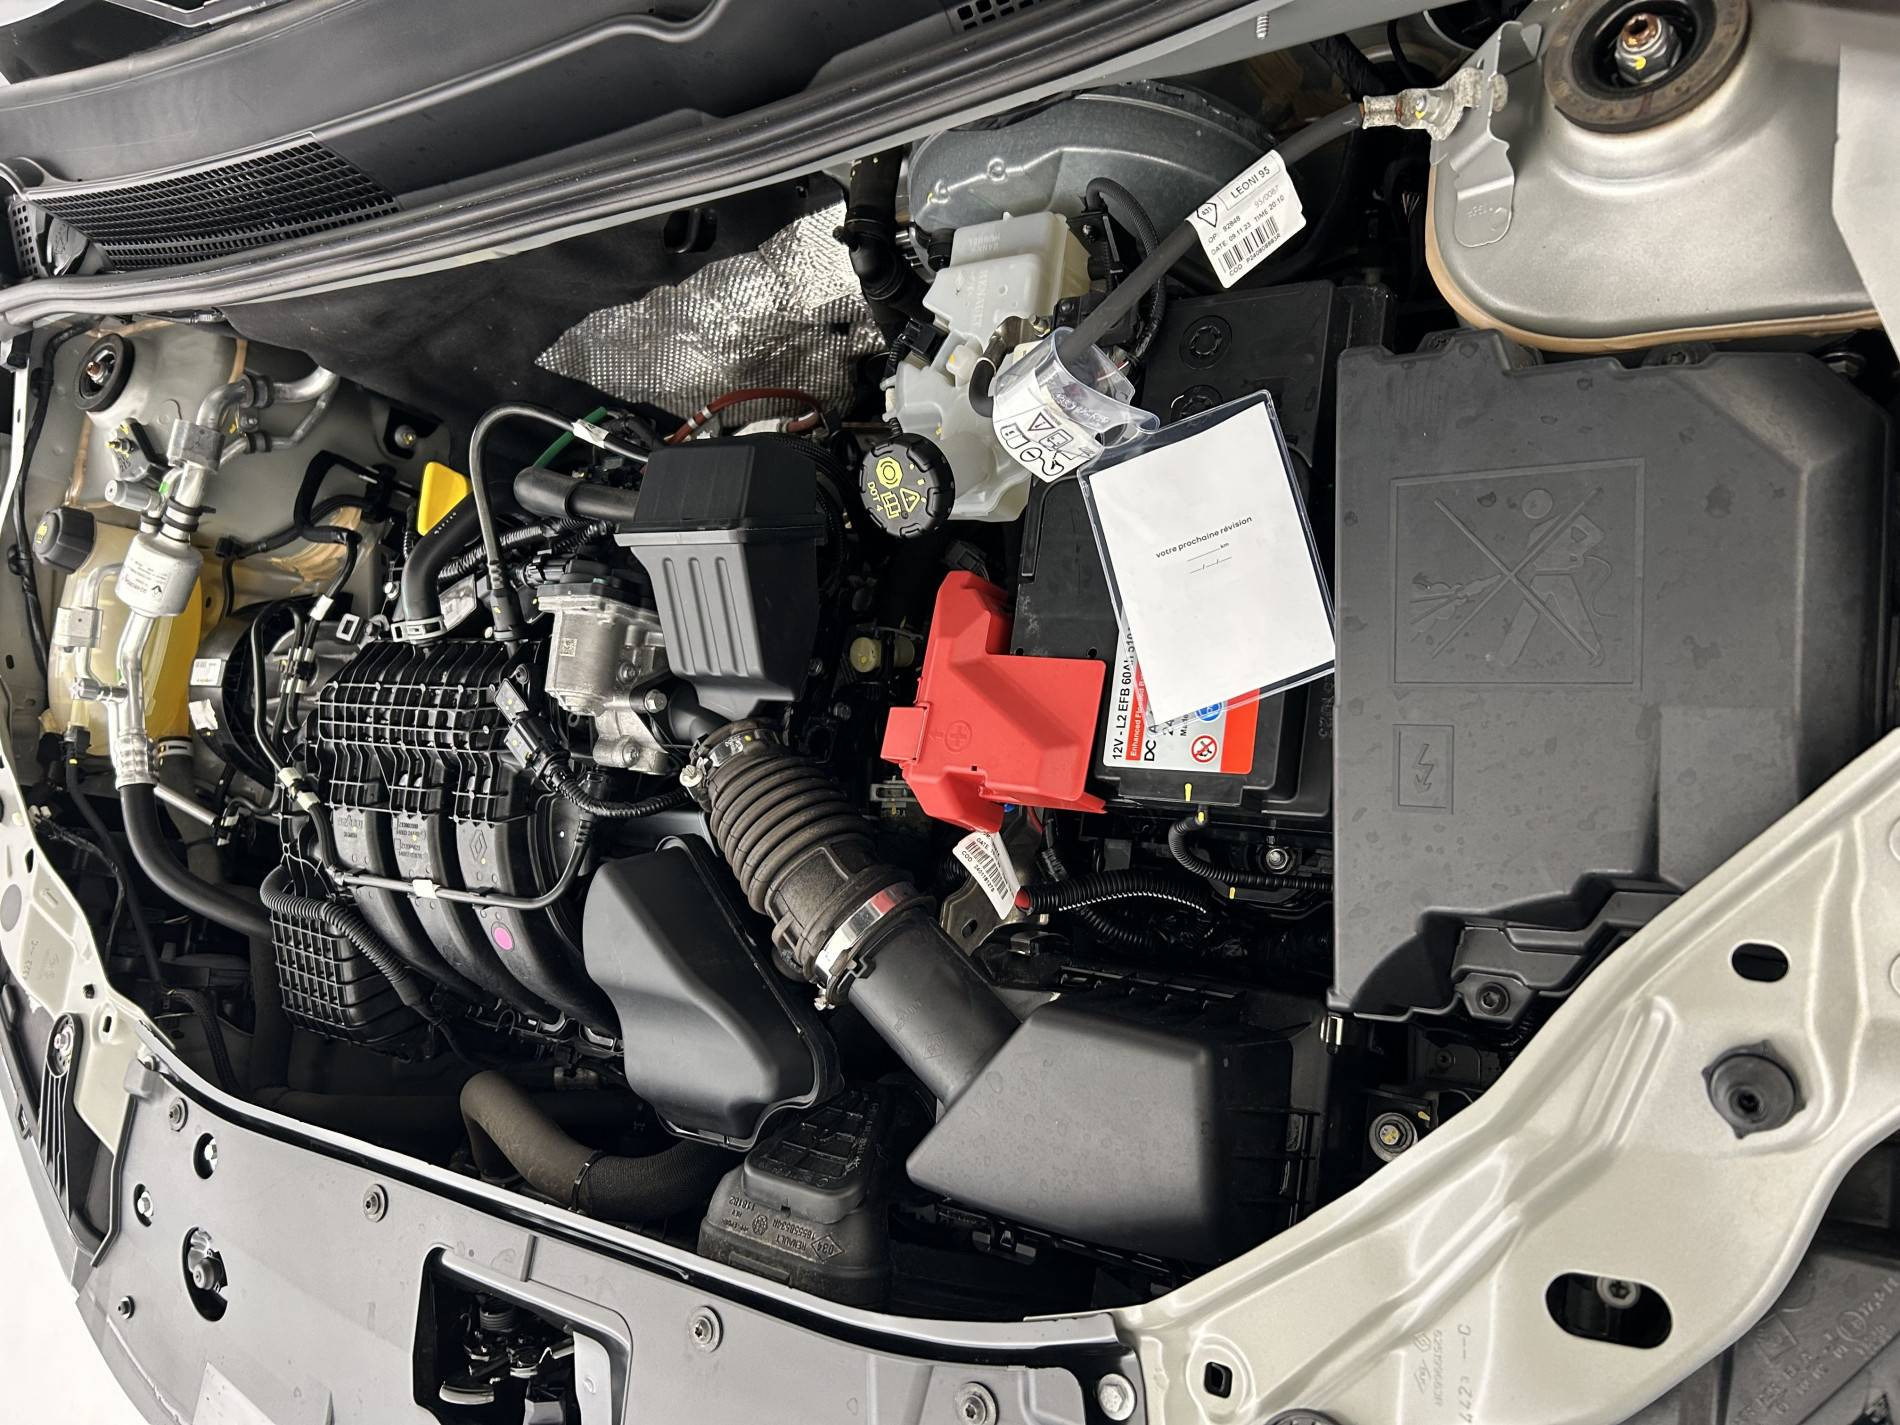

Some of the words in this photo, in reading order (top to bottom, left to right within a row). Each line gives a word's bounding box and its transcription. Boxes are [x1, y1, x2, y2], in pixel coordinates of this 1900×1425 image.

[1230, 174, 1259, 199] LEONI
[1258, 166, 1271, 179] 95
[867, 481, 881, 502] DOT
[876, 504, 884, 512] 4
[1155, 546, 1177, 559] votre
[1178, 530, 1219, 551] prochaine
[1220, 516, 1253, 534] révision
[1117, 687, 1130, 712] EFB
[1116, 714, 1127, 729] L2
[1112, 738, 1124, 760] 12V
[1130, 718, 1141, 757] Enhanced
[1143, 739, 1157, 762] DC
[775, 1234, 807, 1251] RENAULT
